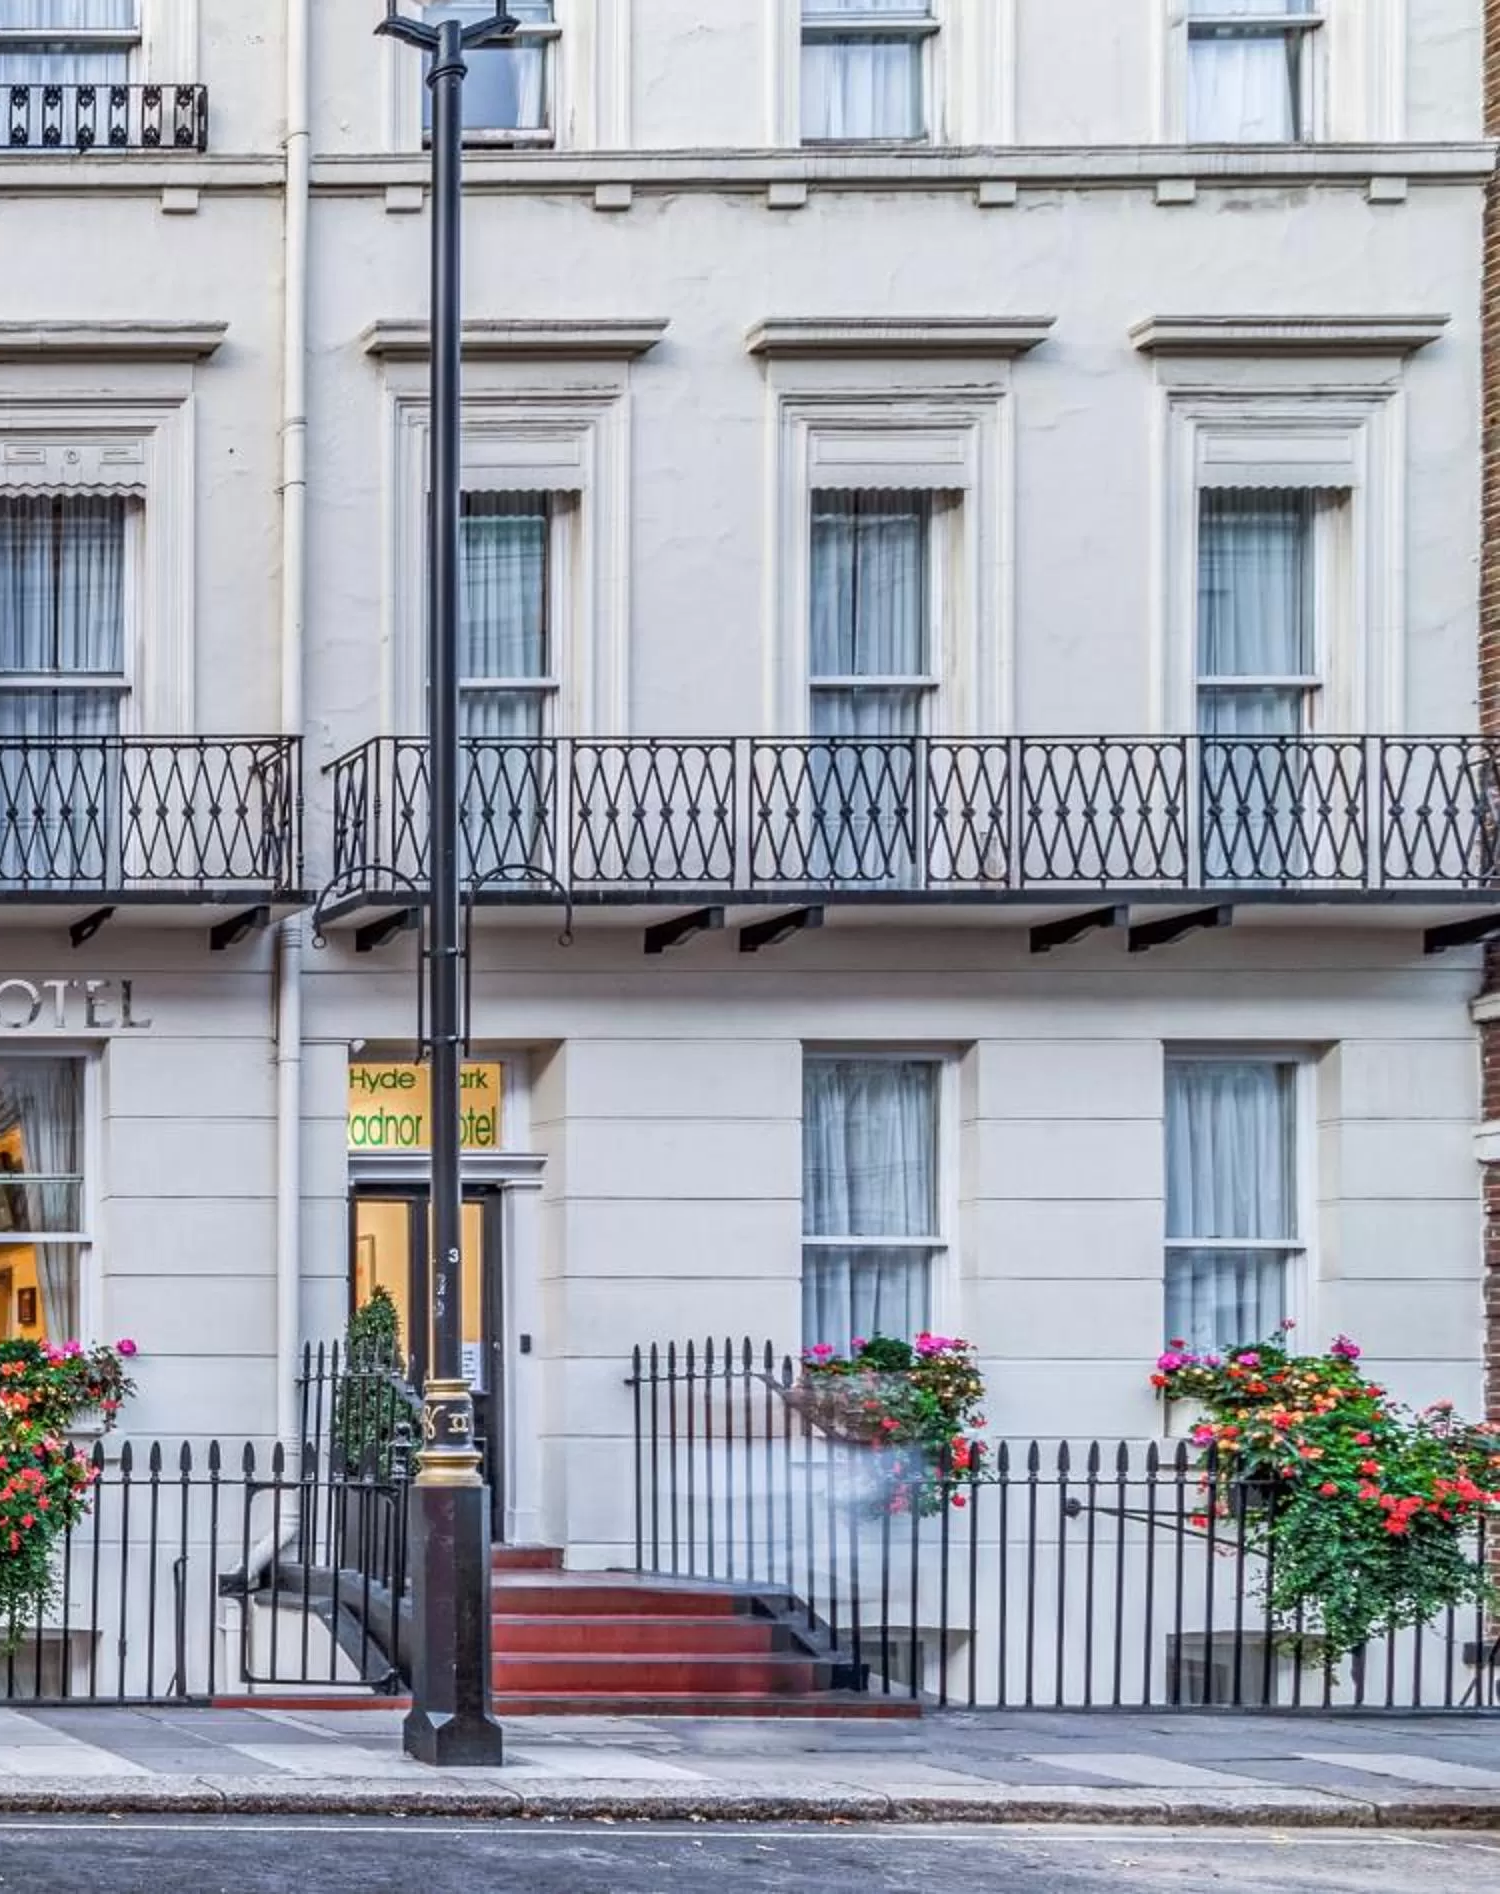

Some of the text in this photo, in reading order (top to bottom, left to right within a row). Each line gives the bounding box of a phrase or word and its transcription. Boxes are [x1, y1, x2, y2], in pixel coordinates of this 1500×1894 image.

[350, 1068, 488, 1094] Hyde ark
[348, 1105, 496, 1145] adnor otel
[448, 1248, 460, 1263] 3
